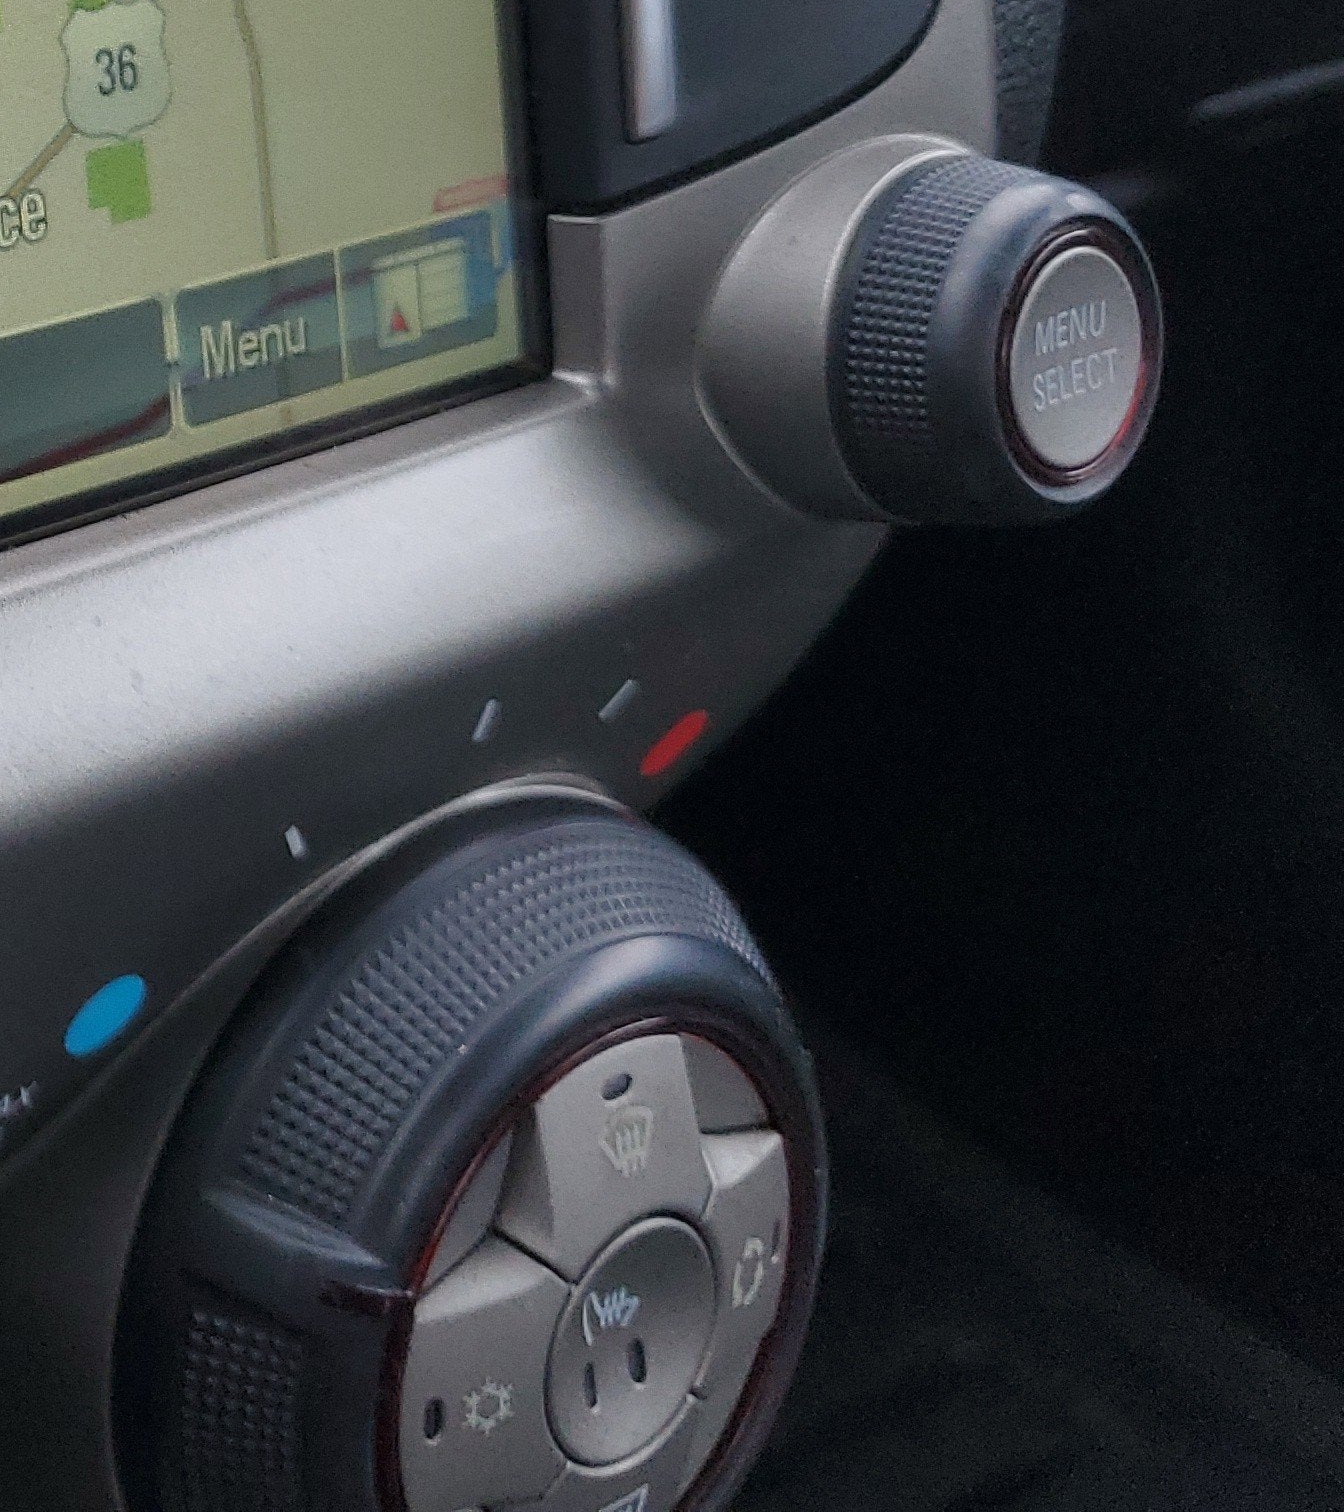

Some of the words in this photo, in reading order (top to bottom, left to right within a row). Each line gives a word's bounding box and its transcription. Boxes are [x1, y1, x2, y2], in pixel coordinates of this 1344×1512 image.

[94, 43, 140, 97] 36
[198, 312, 308, 380] Menu
[1033, 299, 1110, 358] MENU
[1031, 348, 1120, 412] SELECT
